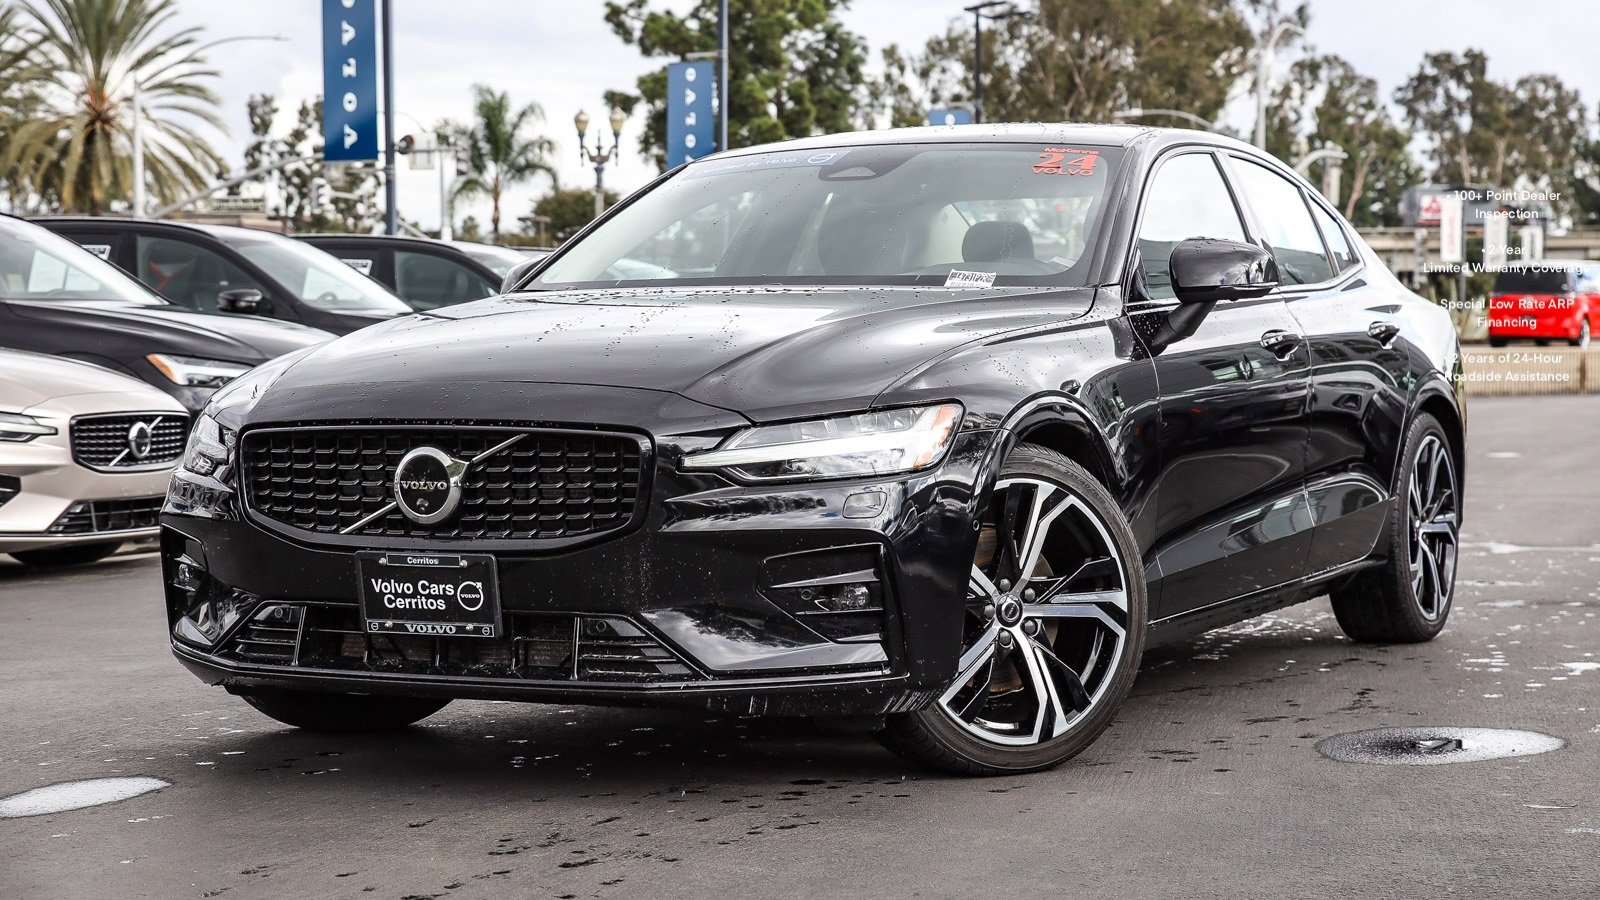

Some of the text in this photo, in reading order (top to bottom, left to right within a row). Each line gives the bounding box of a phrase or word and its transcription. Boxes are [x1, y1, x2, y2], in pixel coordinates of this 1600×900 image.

[1033, 152, 1098, 170] 24
[1032, 167, 1094, 176] VOLVO
[400, 480, 448, 490] VOLVO
[406, 556, 439, 565] Cerritos
[370, 578, 455, 596] Volvo Cars
[383, 594, 447, 610] Cerritos
[404, 623, 456, 634] VOLVO
